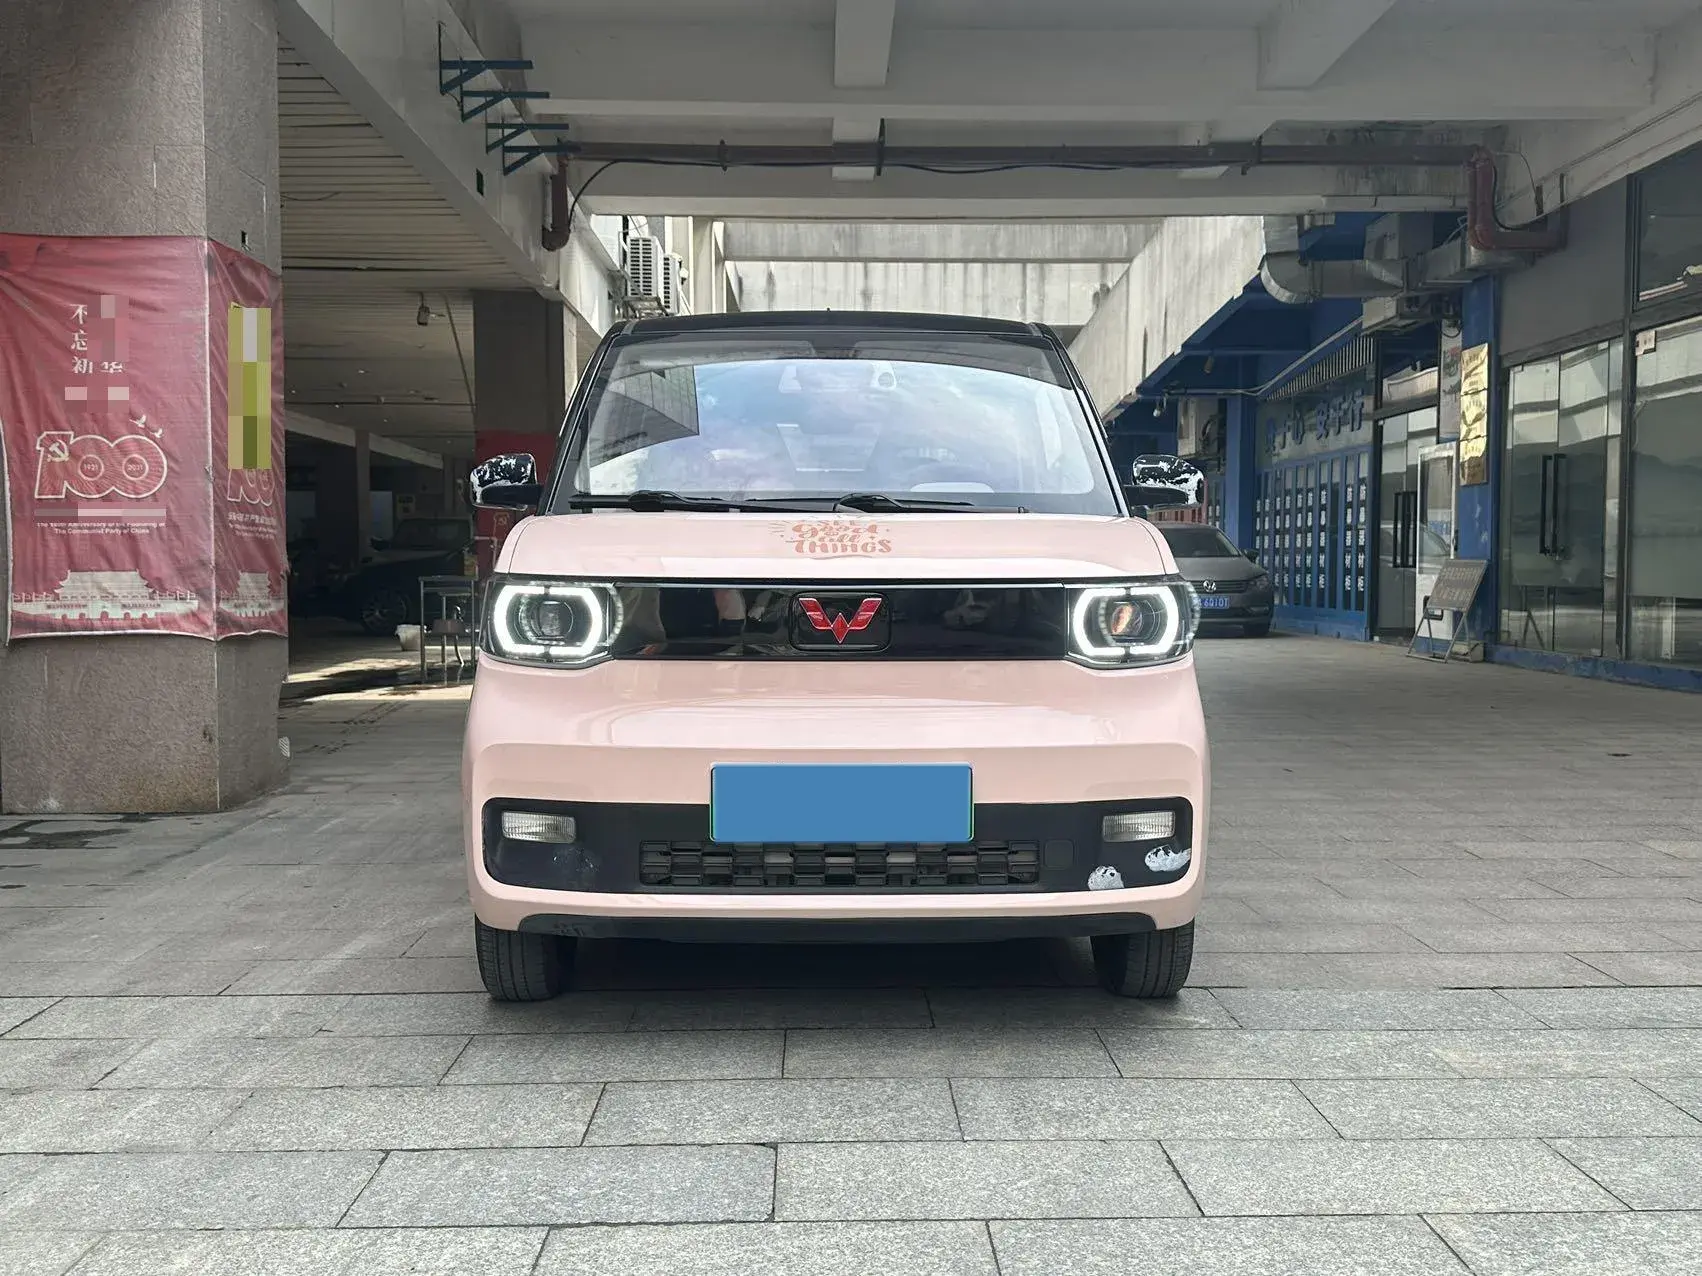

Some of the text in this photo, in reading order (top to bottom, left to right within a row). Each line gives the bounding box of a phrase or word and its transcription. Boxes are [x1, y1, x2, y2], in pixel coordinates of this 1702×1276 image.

[70, 303, 94, 374] 不忘初
[34, 431, 168, 499] 100
[105, 528, 122, 536] Party
[130, 527, 150, 535] China
